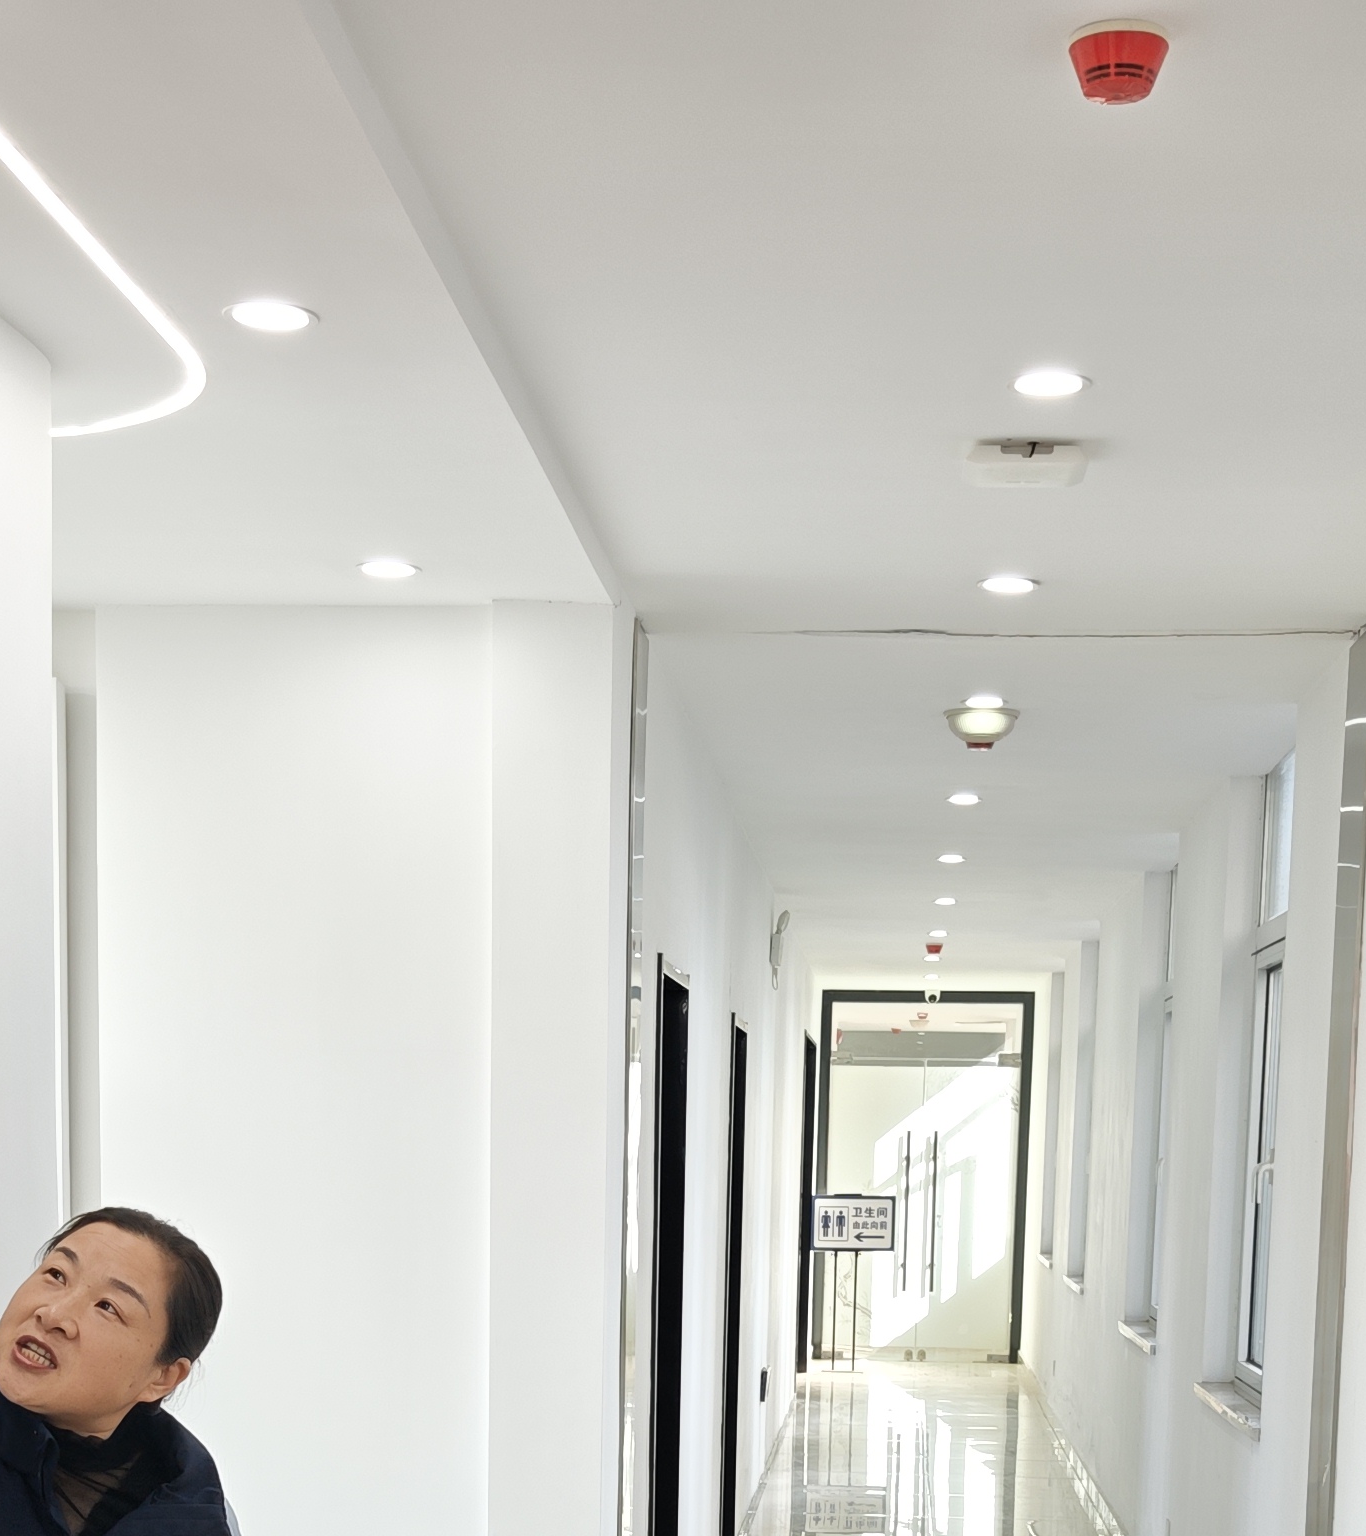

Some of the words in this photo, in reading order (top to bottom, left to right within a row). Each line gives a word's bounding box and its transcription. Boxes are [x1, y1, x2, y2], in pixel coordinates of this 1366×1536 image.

[852, 1206, 888, 1219] 卫生间
[852, 1221, 888, 1230] 由此向前
